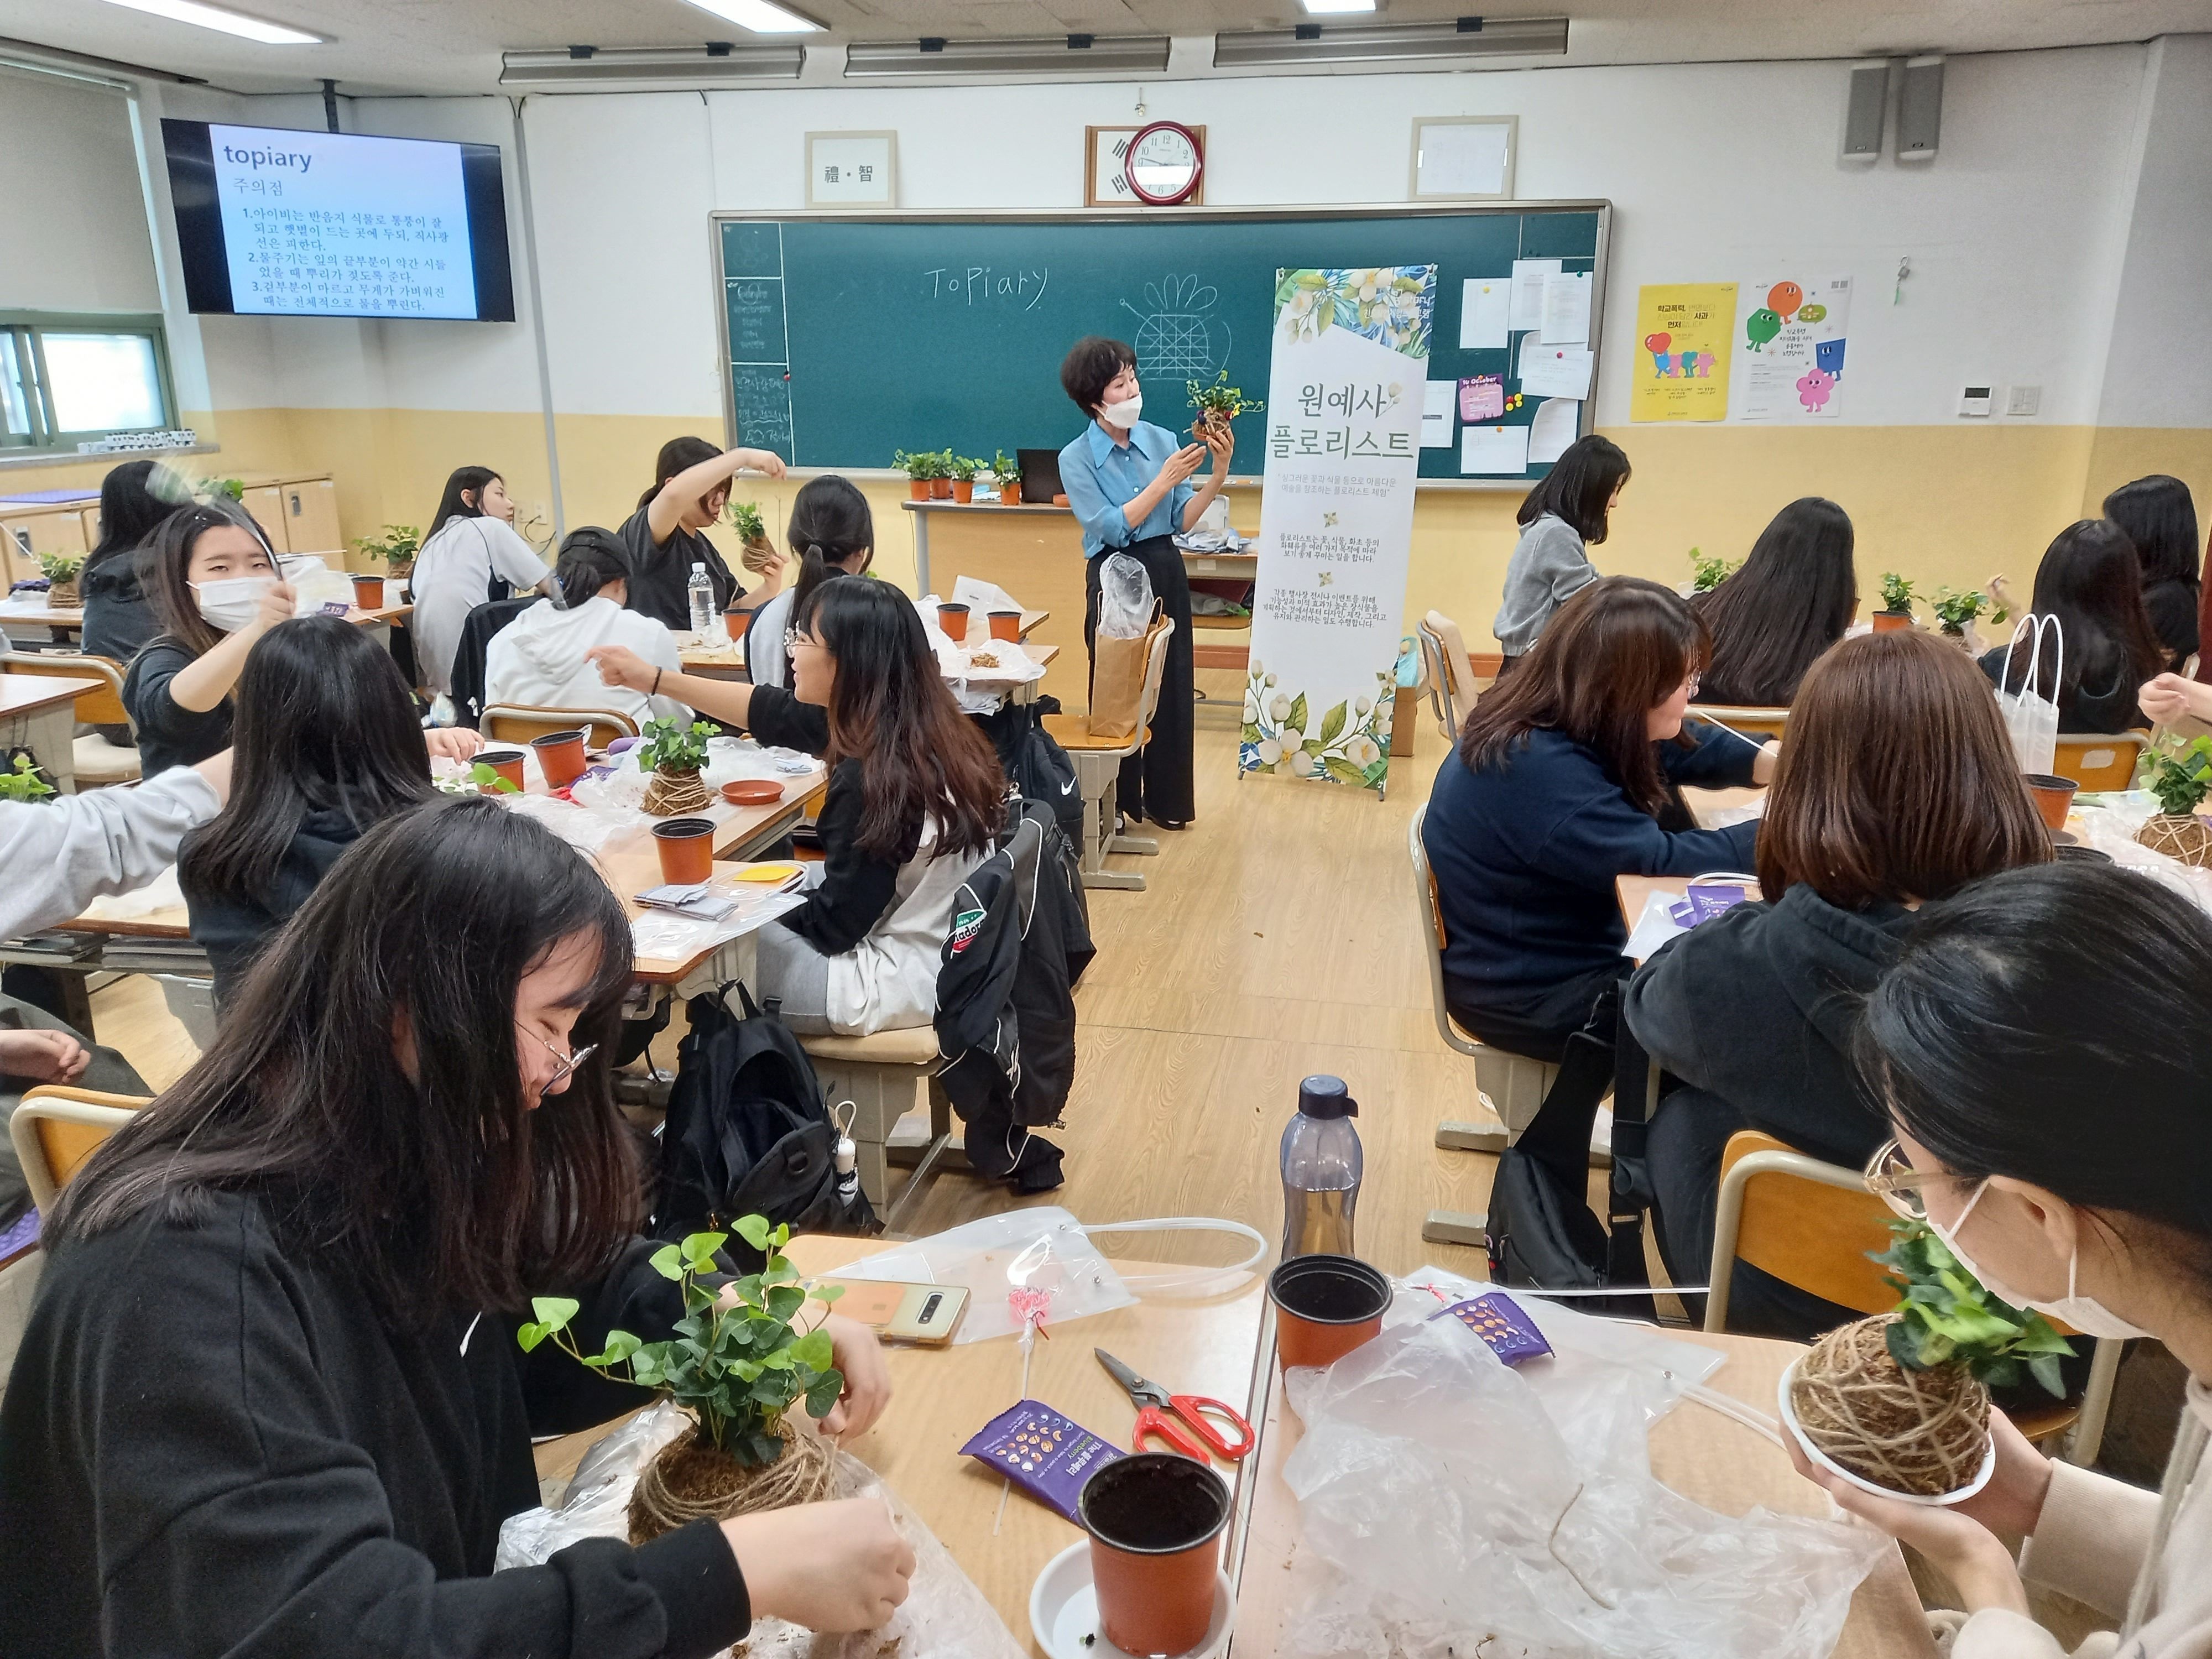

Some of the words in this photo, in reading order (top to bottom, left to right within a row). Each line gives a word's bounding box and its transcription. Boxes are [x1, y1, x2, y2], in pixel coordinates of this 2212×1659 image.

[1151, 137, 1157, 147] 11
[1162, 134, 1171, 144] 12
[1177, 139, 1181, 149] 1
[1141, 146, 1149, 155] 10
[1182, 149, 1188, 159] 2
[223, 145, 312, 174] topiary
[234, 178, 283, 196] 주의점
[1158, 185, 1164, 195] 6
[309, 211, 345, 224] 반음지
[351, 213, 386, 225] 식물로
[392, 215, 425, 228] 통풍이
[432, 217, 442, 229] 잘
[254, 222, 279, 234] 되고
[326, 227, 349, 238] 드는
[356, 228, 378, 239] 곳에
[415, 230, 448, 243] 직사광
[257, 237, 280, 249] 선은
[286, 238, 326, 252] 피한다.
[314, 254, 337, 266] 잎의
[343, 256, 390, 269] 끝부분이
[396, 257, 419, 269] 약간
[424, 258, 446, 270] 시들
[259, 266, 283, 279] 었을
[289, 268, 300, 279] 때
[306, 268, 343, 280] 뿌리가
[388, 272, 414, 283] 준다.
[318, 283, 354, 294] 마르고
[359, 284, 394, 296] 무게가
[264, 295, 288, 307] 때는
[294, 296, 354, 308] 전체적으로
[359, 298, 382, 310] 물을
[387, 299, 425, 311] 뿌린다.
[1298, 382, 1387, 419] 원예사
[1270, 424, 1414, 460] 플로리스트
[1343, 476, 1364, 485] 등으로
[1366, 477, 1396, 487] 아름다운
[1088, 1441, 1103, 1454] The
